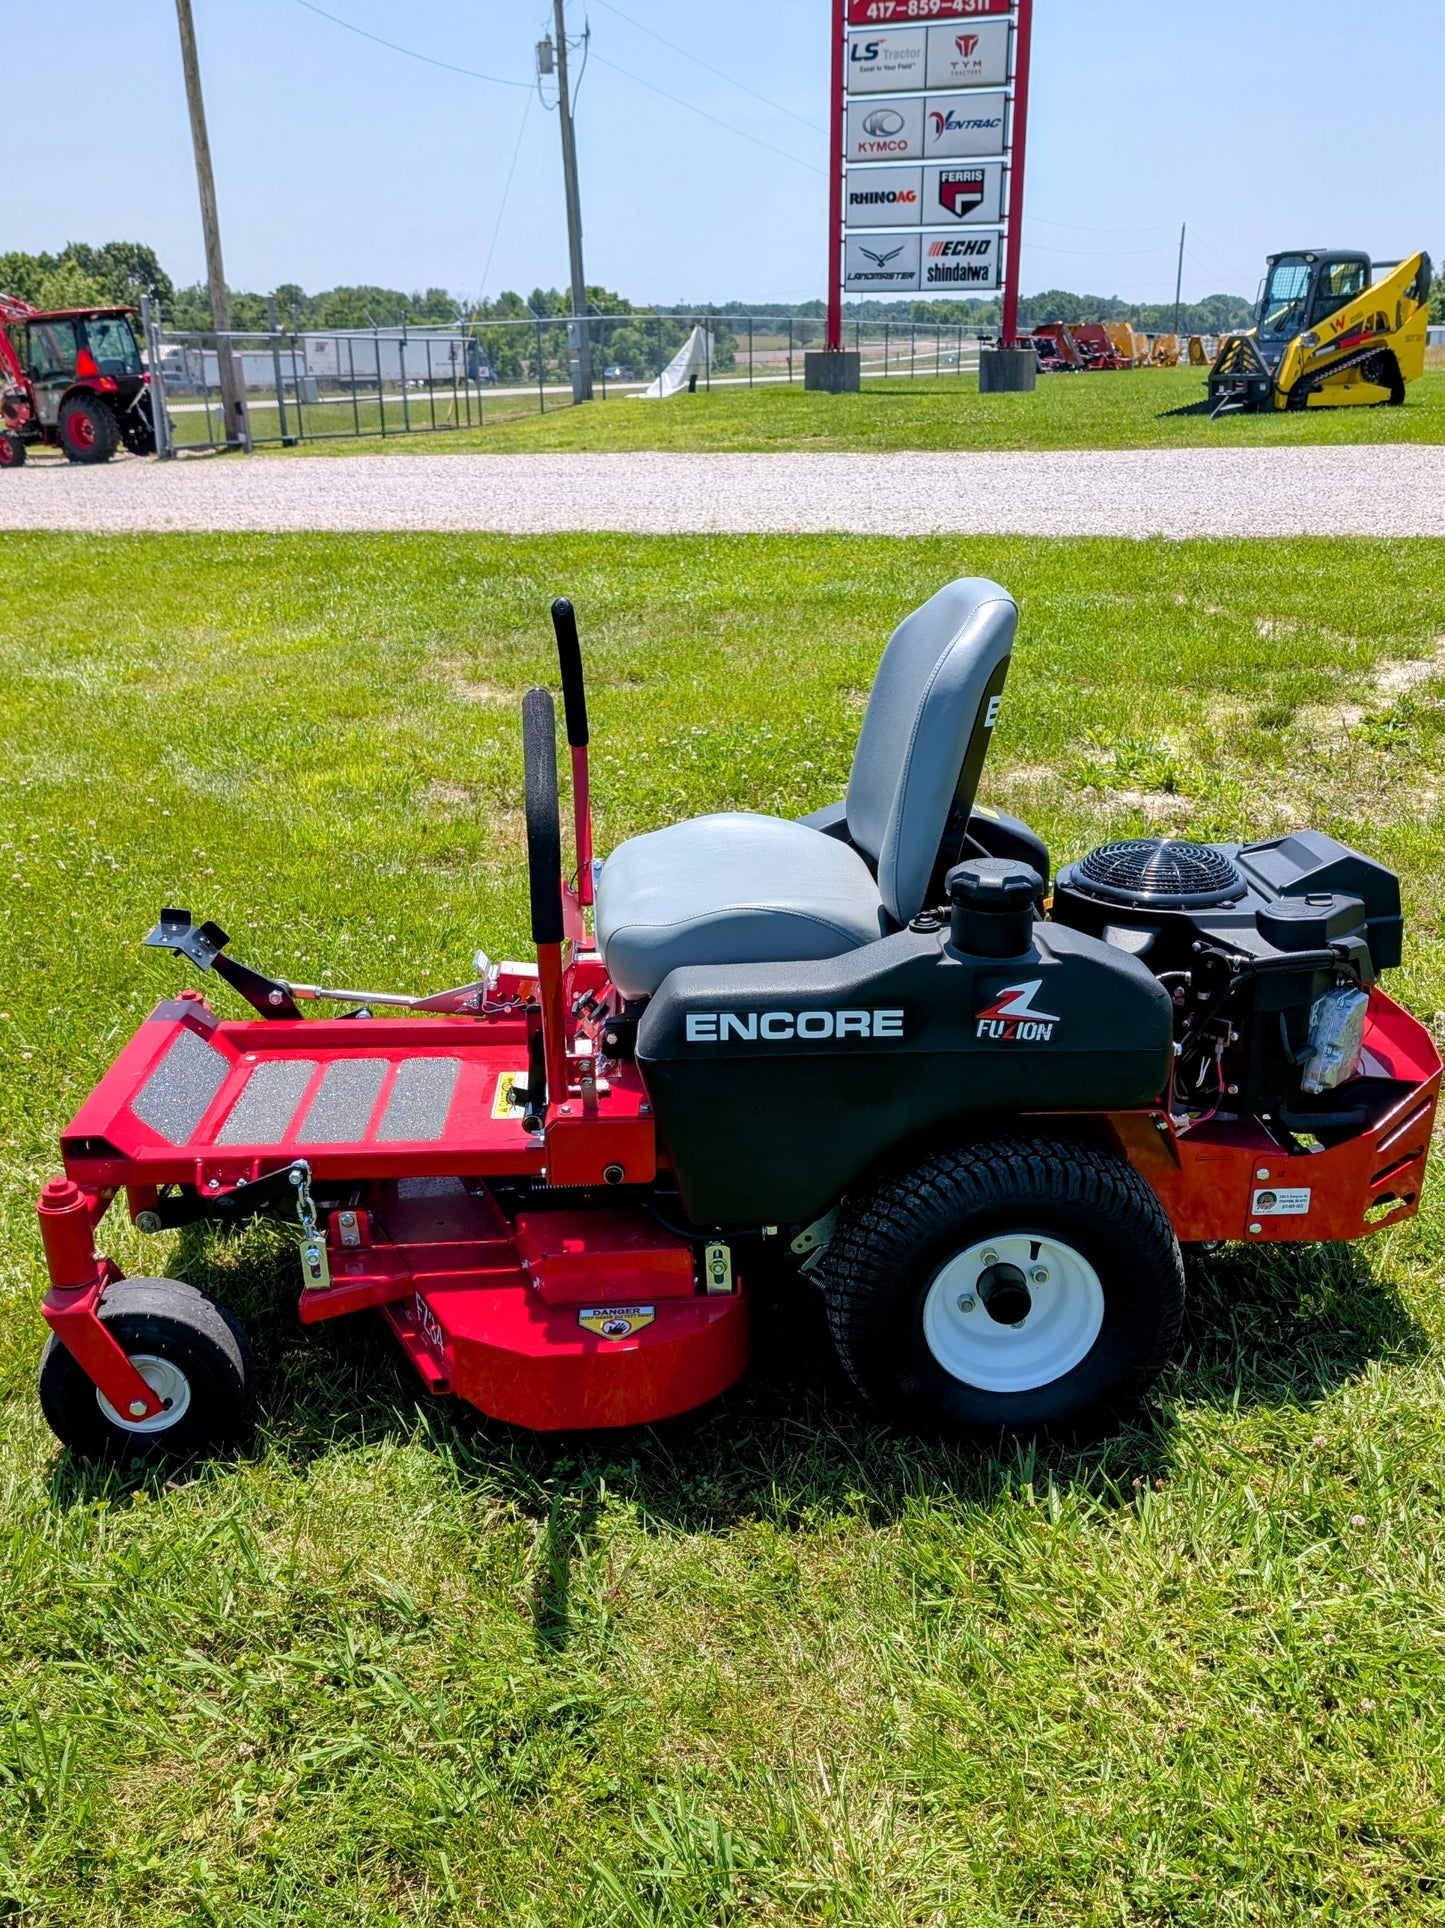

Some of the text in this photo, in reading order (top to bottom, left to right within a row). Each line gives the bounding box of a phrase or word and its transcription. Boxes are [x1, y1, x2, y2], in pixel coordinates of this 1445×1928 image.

[867, 0, 990, 19] 417-859-4311
[851, 42, 921, 61] LS Tractor
[950, 60, 982, 69] TYM
[929, 110, 1001, 142] VENTRAC
[858, 140, 908, 152] KYMCO
[942, 171, 983, 182] FERRIS
[850, 190, 917, 205] RHINOAG
[941, 240, 991, 255] ECHO
[847, 272, 915, 280] LANDMASTER
[927, 262, 989, 282] shindaiwa
[686, 1010, 904, 1042] ENCORE
[976, 1019, 1053, 1041] FUZION
